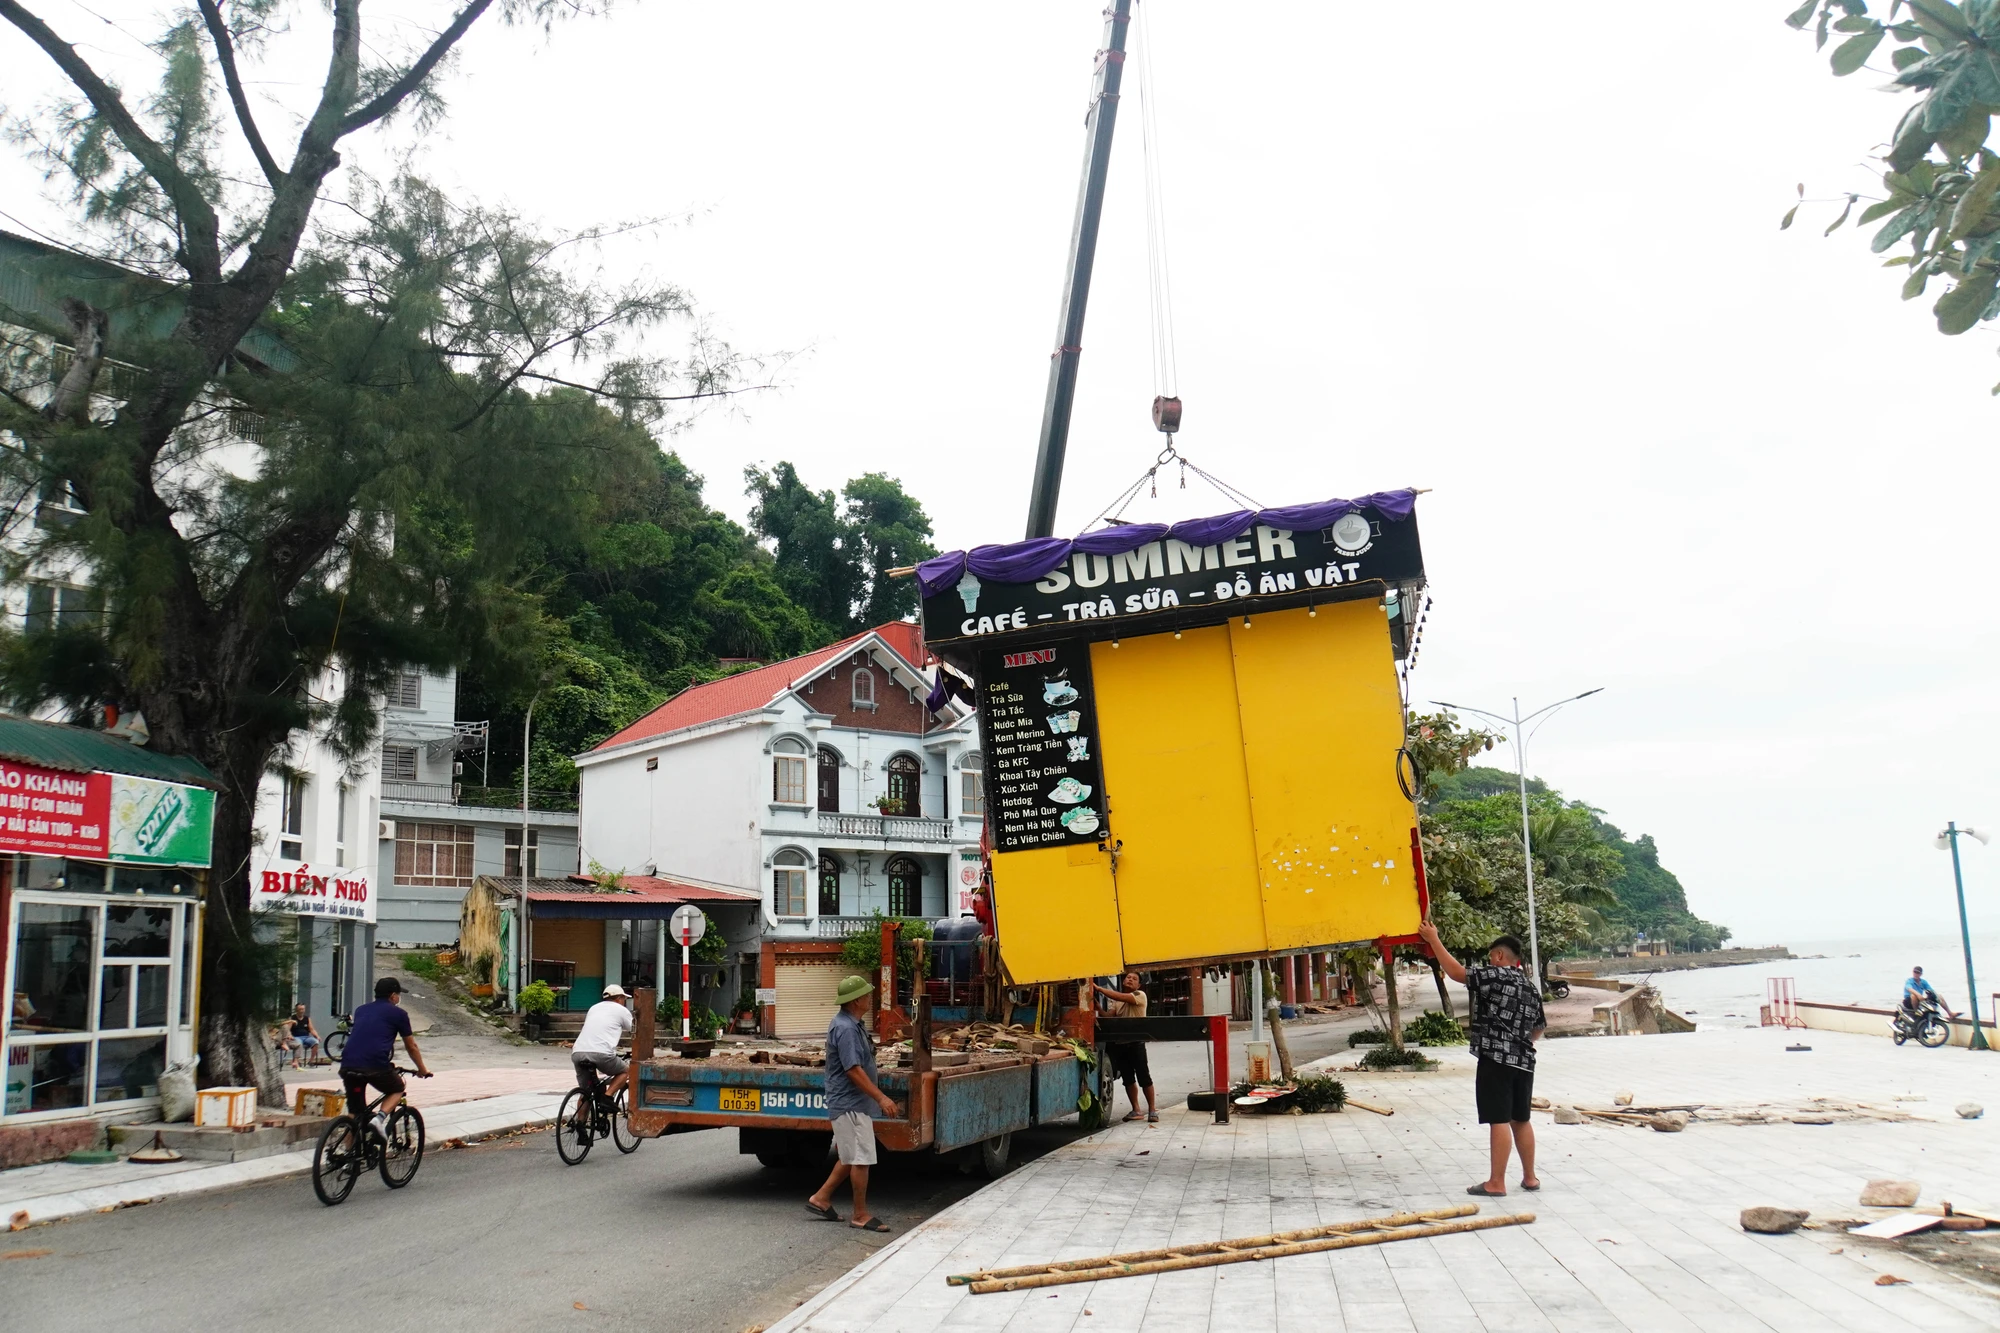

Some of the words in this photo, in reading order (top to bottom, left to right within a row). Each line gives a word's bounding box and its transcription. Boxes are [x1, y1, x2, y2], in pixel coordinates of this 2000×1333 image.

[1334, 546, 1355, 557] FRESH
[1355, 542, 1373, 556] JUICE
[1036, 526, 1297, 594] SUMMER
[961, 606, 1028, 636] CAFÉ
[1062, 594, 1116, 621] TRÀ
[1125, 587, 1180, 613] SỮA
[1214, 571, 1251, 600] ĐỒ
[1259, 570, 1296, 594] ĂN
[1304, 561, 1360, 587] VẶT
[1004, 648, 1056, 669] MENU
[990, 682, 1009, 692] Café
[995, 734, 1014, 743] Kem
[1016, 730, 1045, 740] Merino
[996, 746, 1015, 756] Kem
[998, 759, 1010, 768] Gà
[1012, 757, 1029, 767] KFC
[1000, 771, 1023, 781] Khoai
[1025, 769, 1041, 778] Tây
[1043, 766, 1067, 776] Chiên
[0, 765, 21, 788] ẢO
[24, 774, 87, 797] KHÁNH
[1001, 785, 1017, 794] Xúc
[1002, 797, 1033, 807] Hotdog
[138, 789, 179, 847] Sprite
[1022, 808, 1038, 818] Mai
[1040, 806, 1057, 816] Que
[1005, 824, 1024, 833] Nem
[1026, 820, 1038, 830] Hà
[1041, 832, 1065, 842] Chiên
[261, 863, 330, 897] BIỂN
[334, 877, 368, 903] NHỚ
[732, 1089, 750, 1099] 15H
[723, 1099, 757, 1111] 010.39
